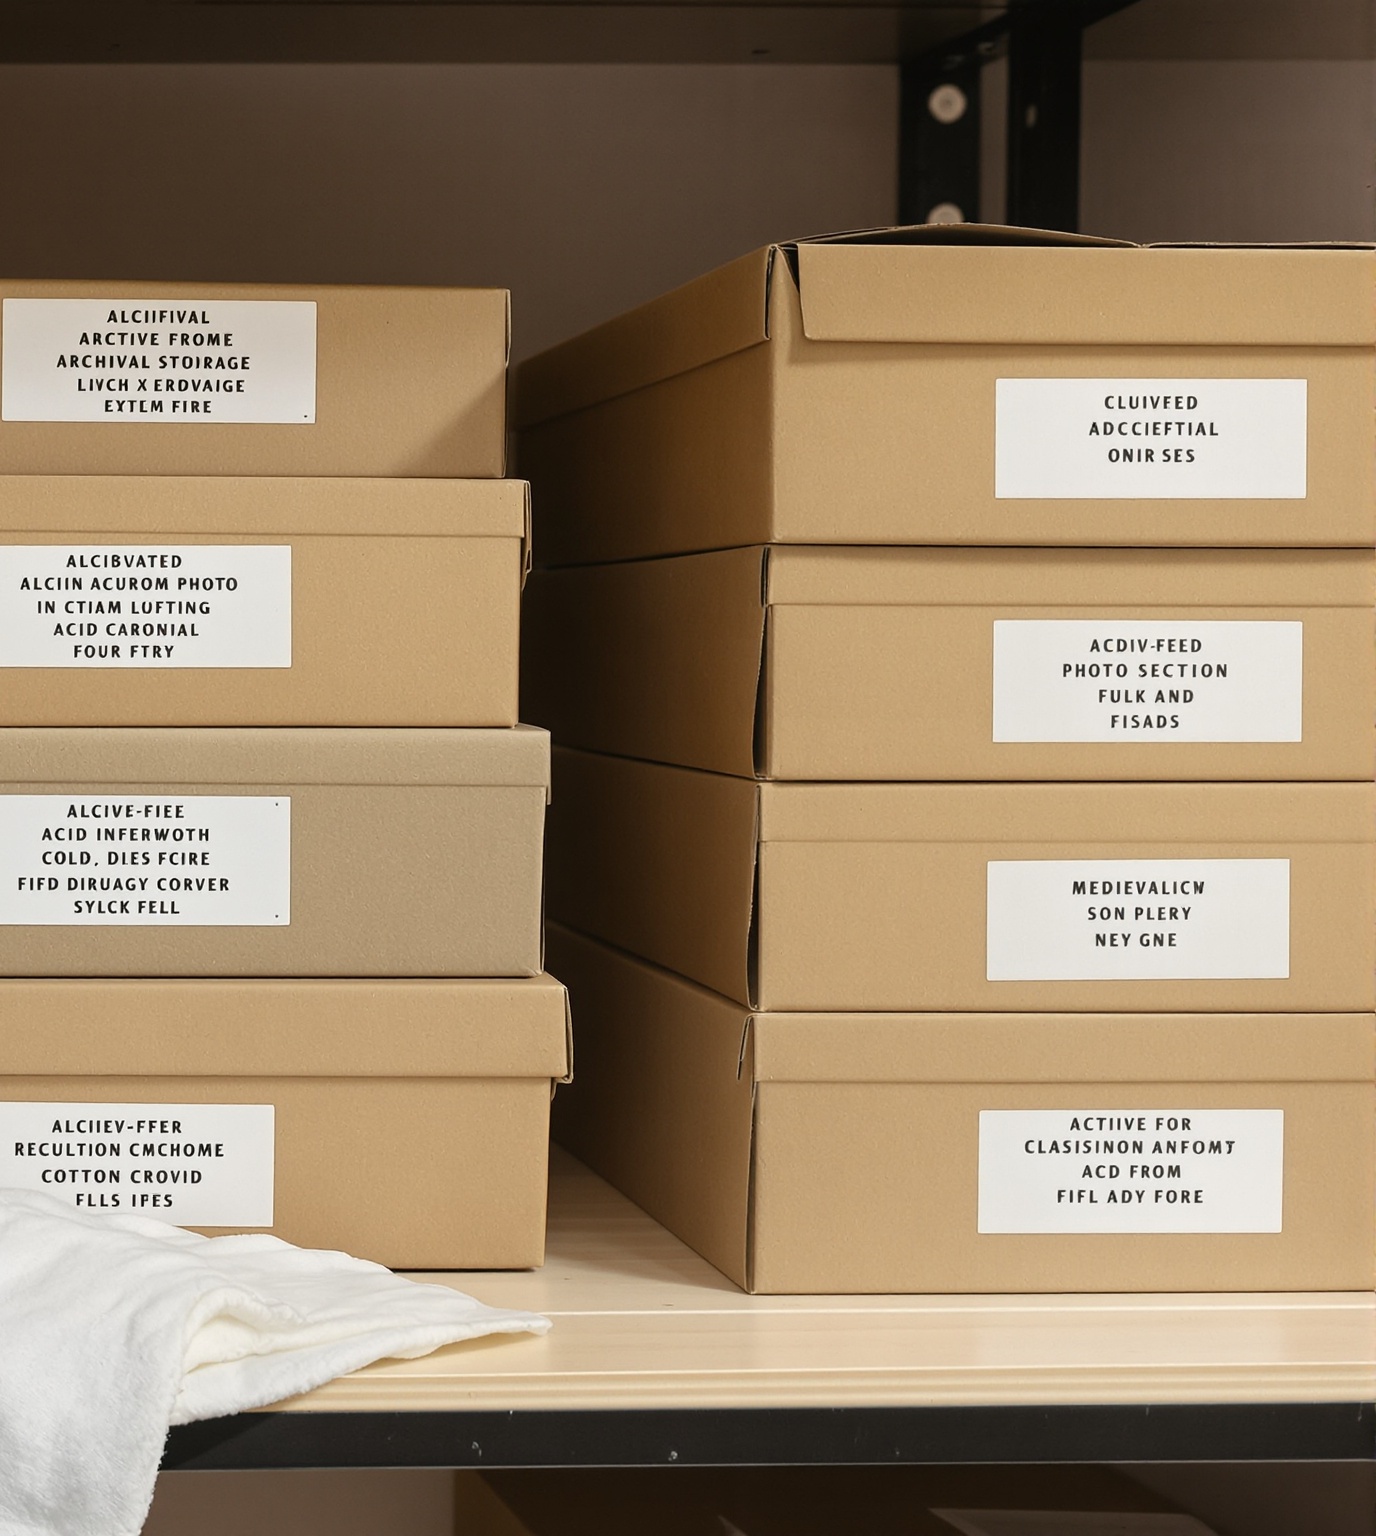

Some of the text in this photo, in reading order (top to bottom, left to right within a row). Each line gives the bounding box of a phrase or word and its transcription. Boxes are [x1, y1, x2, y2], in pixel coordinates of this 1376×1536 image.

[78, 331, 233, 347] ARCTIVE FROME
[56, 354, 151, 369] ARCHIVAL
[136, 378, 148, 392] X
[153, 378, 245, 393] ERDVAIGE
[171, 400, 212, 414] FIRE
[1088, 421, 1219, 436] ADCCIEFTIAL
[1107, 448, 1195, 463] ONIR SES
[20, 576, 238, 592] ALCIIN ACUROM PHOTO
[37, 600, 211, 615] IN CTIAM LUFTING
[53, 622, 200, 637] ACID CARONIAL
[73, 644, 174, 659] FOUR FTRY
[1089, 638, 1202, 653] ACDIV-FEED
[1062, 663, 1227, 678] PHOTO SECTION
[1098, 689, 1194, 704] FULK AND
[1110, 714, 1179, 729] FISADS
[66, 804, 185, 819] ALCIVE-FIEE
[41, 827, 210, 842] ACID INFERWOTH
[41, 850, 99, 867] COLD,
[158, 851, 210, 866] FCIRE
[18, 877, 230, 892] FIFD DIRUAGY CORVER
[73, 900, 180, 915] SYLCK FELL
[1087, 906, 1192, 921] SON PLERY
[1095, 932, 1177, 948] NEY GNE
[51, 1119, 182, 1134] ALCIIEV-FFER
[1069, 1117, 1191, 1132] ACTIIVE FOR
[14, 1142, 224, 1158] RECULTION CMCHOME
[1024, 1139, 1143, 1154] CLASISINON
[41, 1169, 202, 1184] COTTON CROVID
[1081, 1164, 1181, 1179] ACD FROM
[76, 1193, 120, 1208] FLLS
[1057, 1189, 1203, 1204] FIFL ADY FORE
